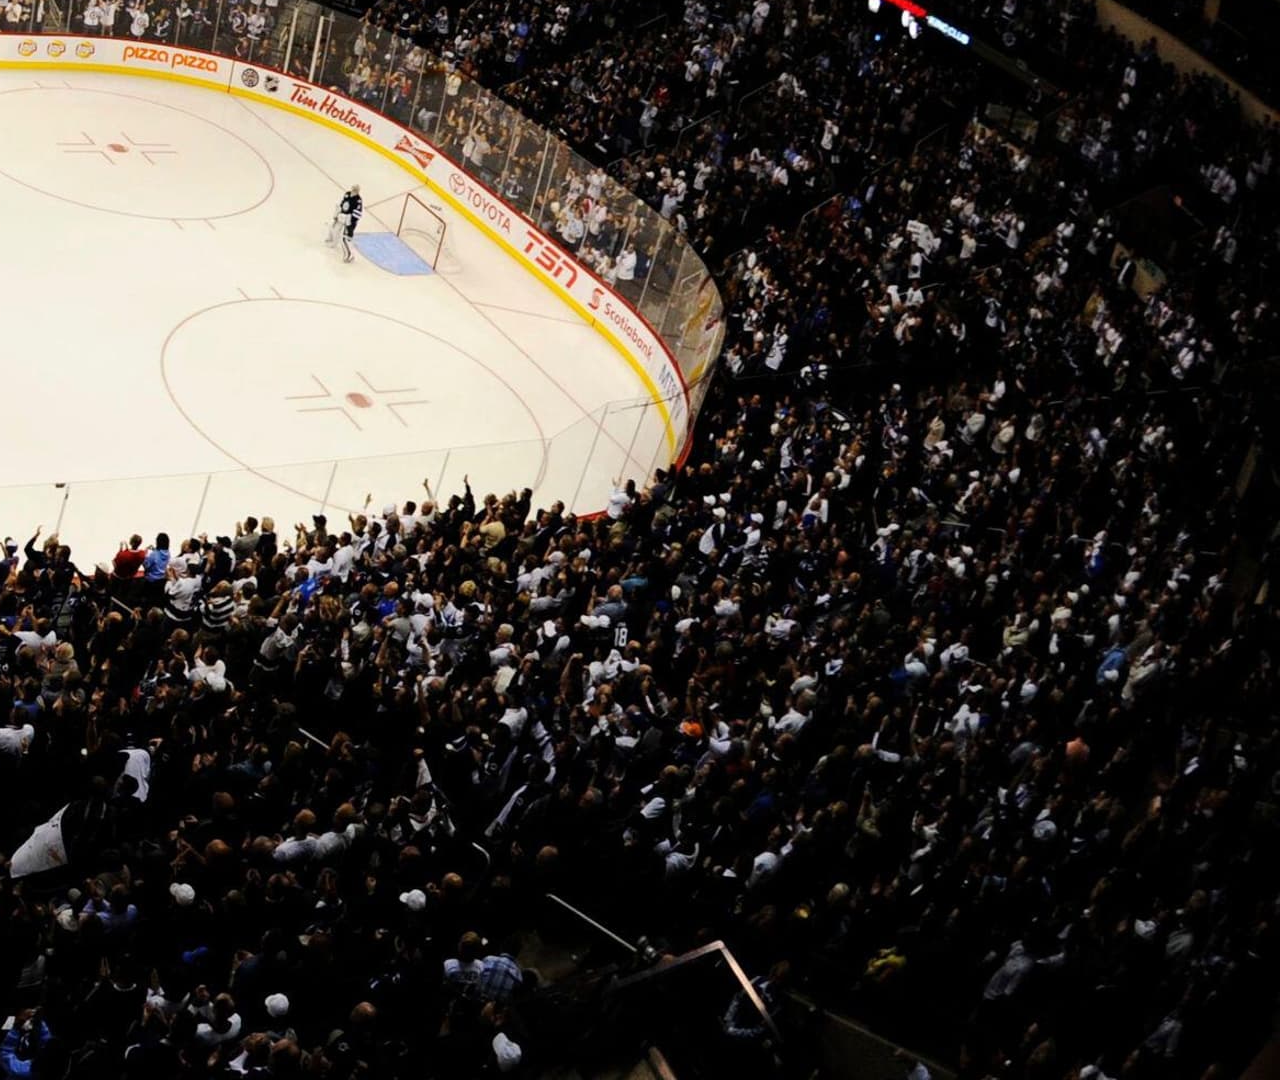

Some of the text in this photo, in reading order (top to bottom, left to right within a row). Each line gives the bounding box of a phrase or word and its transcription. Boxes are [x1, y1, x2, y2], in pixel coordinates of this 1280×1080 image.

[123, 45, 218, 73] pizza pizza
[290, 82, 372, 136] Tim Hortons
[467, 186, 512, 233] TOYOTA
[522, 230, 578, 289] TSN
[604, 303, 653, 360] Scotiabank
[614, 628, 628, 647] 18
